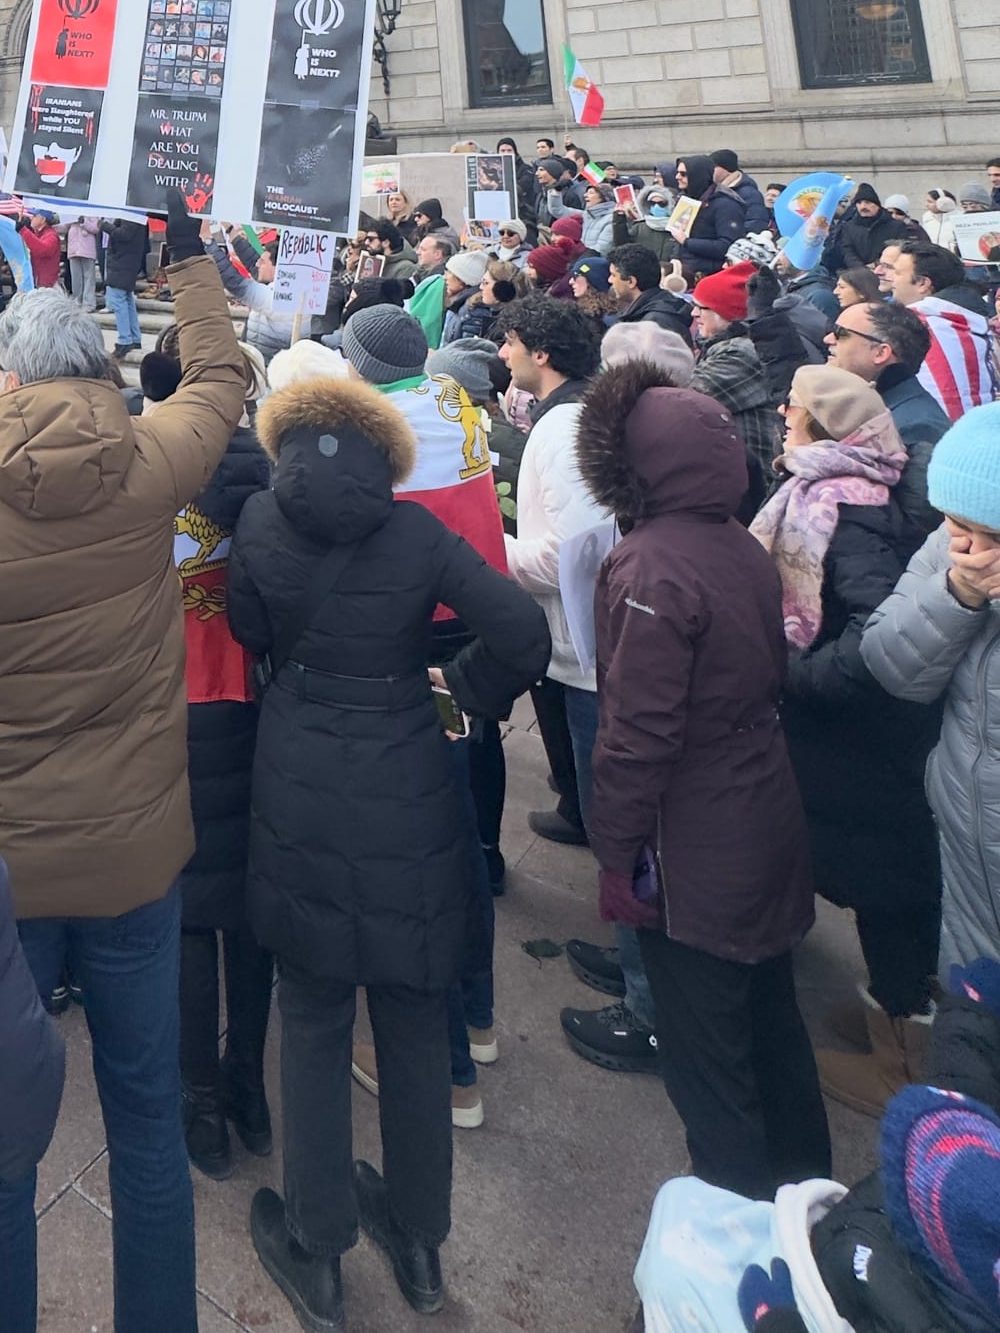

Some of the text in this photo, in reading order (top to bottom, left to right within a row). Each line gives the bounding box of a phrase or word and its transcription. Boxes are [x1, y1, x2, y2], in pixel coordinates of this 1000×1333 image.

[70, 32, 93, 40] WHO
[68, 40, 77, 48] IS
[67, 49, 95, 59] NEXT?
[311, 48, 337, 58] WHO
[310, 57, 320, 66] IS
[309, 67, 341, 78] NEXT?
[45, 97, 82, 108] IRANIANS
[31, 106, 50, 114] were
[42, 115, 80, 125] while YOU
[149, 108, 207, 123] MR. TRUPM
[38, 124, 63, 133] stayed
[160, 124, 193, 138] WHAT
[149, 141, 199, 155] ARE YOU
[148, 156, 199, 172] DEALING
[154, 174, 189, 188] WITH?
[266, 185, 284, 195] THE
[264, 200, 319, 215] HOLOCAUST
[280, 229, 329, 259] REPUBLIC
